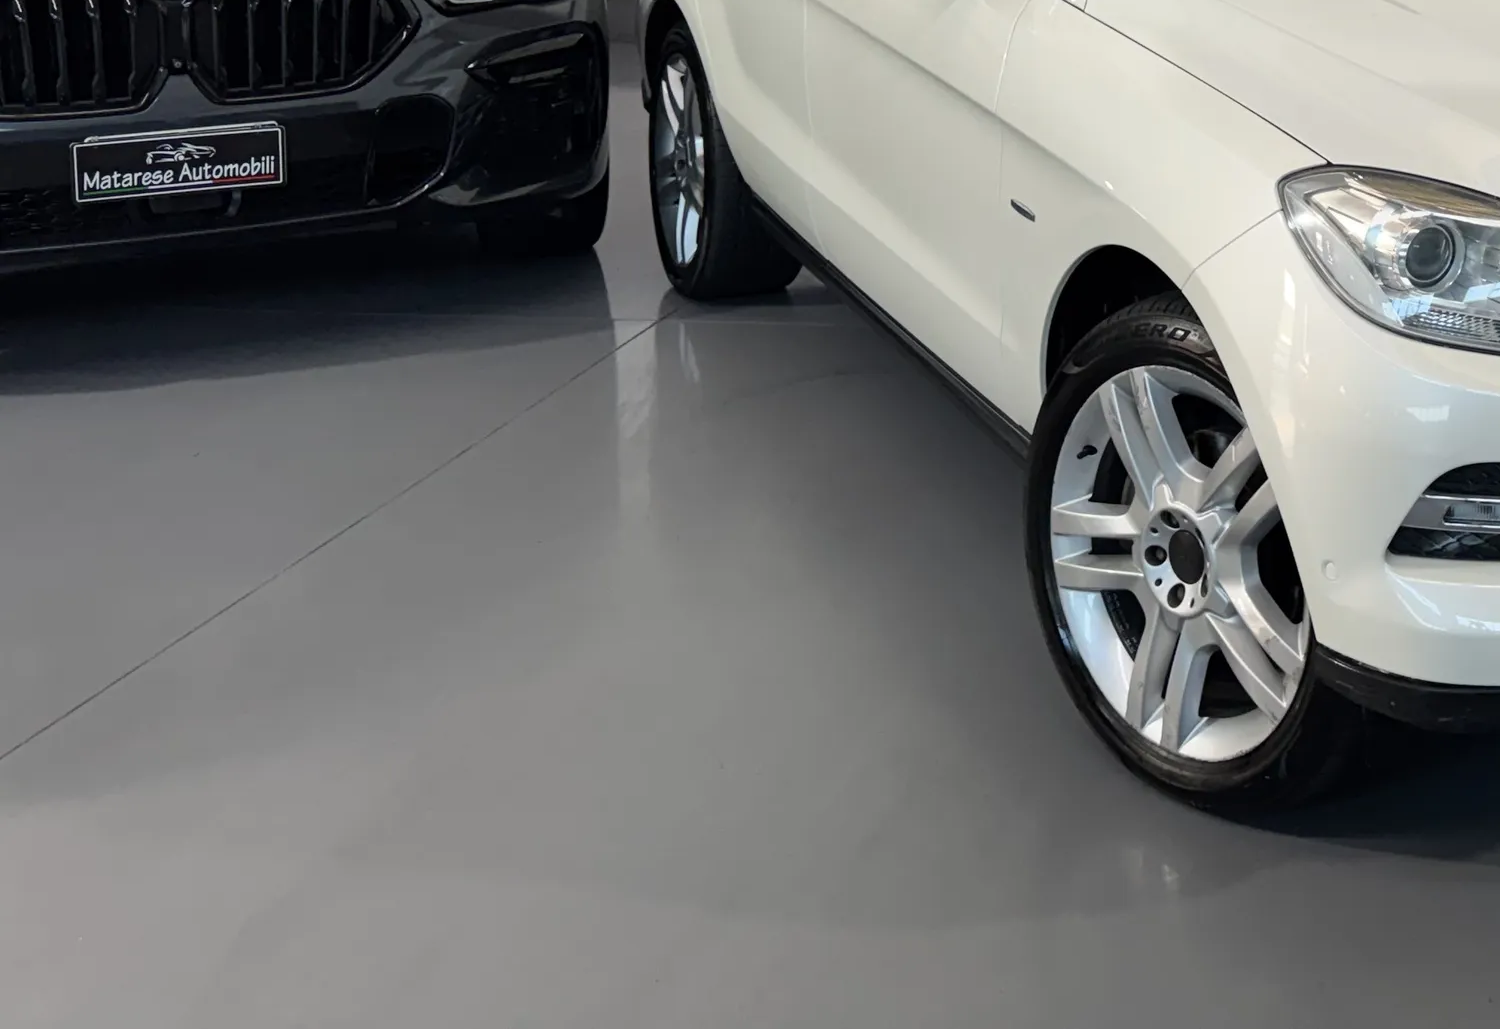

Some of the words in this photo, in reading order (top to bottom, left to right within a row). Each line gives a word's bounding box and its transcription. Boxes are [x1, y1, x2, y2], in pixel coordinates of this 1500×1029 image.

[83, 171, 174, 191] Matarese
[178, 155, 275, 183] Automobili
[1115, 322, 1191, 342] ERO
